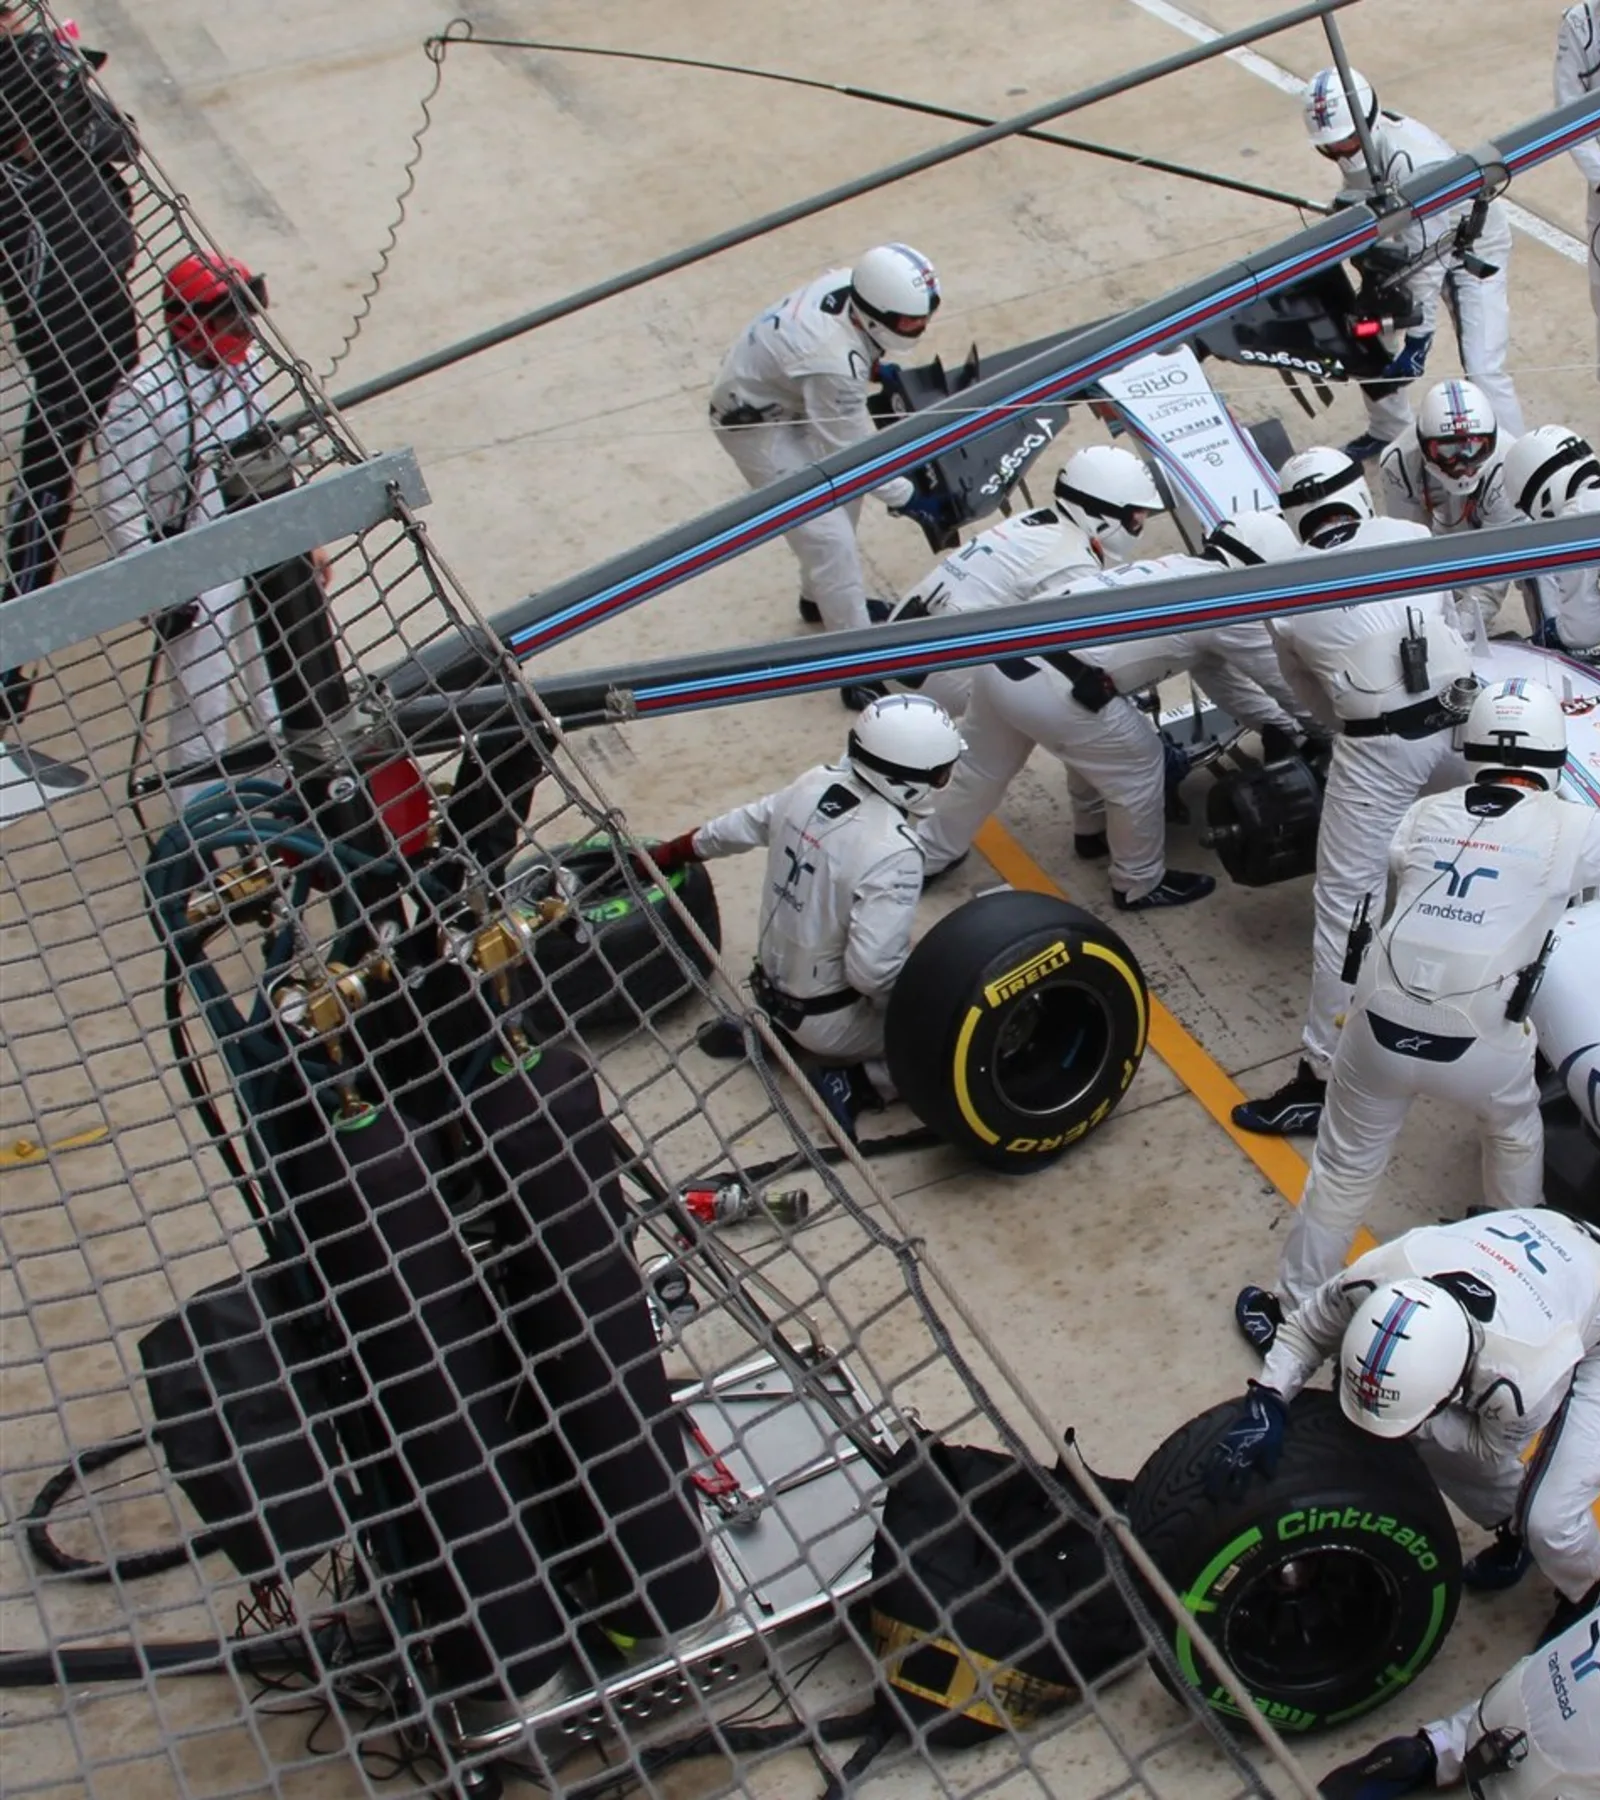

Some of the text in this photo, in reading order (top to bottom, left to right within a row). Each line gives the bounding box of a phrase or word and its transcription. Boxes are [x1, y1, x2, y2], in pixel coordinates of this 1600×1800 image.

[1127, 369, 1189, 399] ORIS
[1147, 395, 1208, 421] HACKETT
[1160, 415, 1223, 444] PIRELLI
[1181, 438, 1230, 460] avanade
[1455, 838, 1500, 853] MARTINI
[1416, 901, 1485, 926] randstad
[984, 940, 1071, 1008] PIRELLI
[1005, 1098, 1111, 1152] ZERO
[1474, 1240, 1554, 1321] WILLIAMS MARTINI
[1346, 1366, 1400, 1402] MARTINI
[1277, 1505, 1439, 1573] Cinturato
[1547, 1650, 1577, 1722] randstad
[1207, 1685, 1318, 1732] PIRELI
